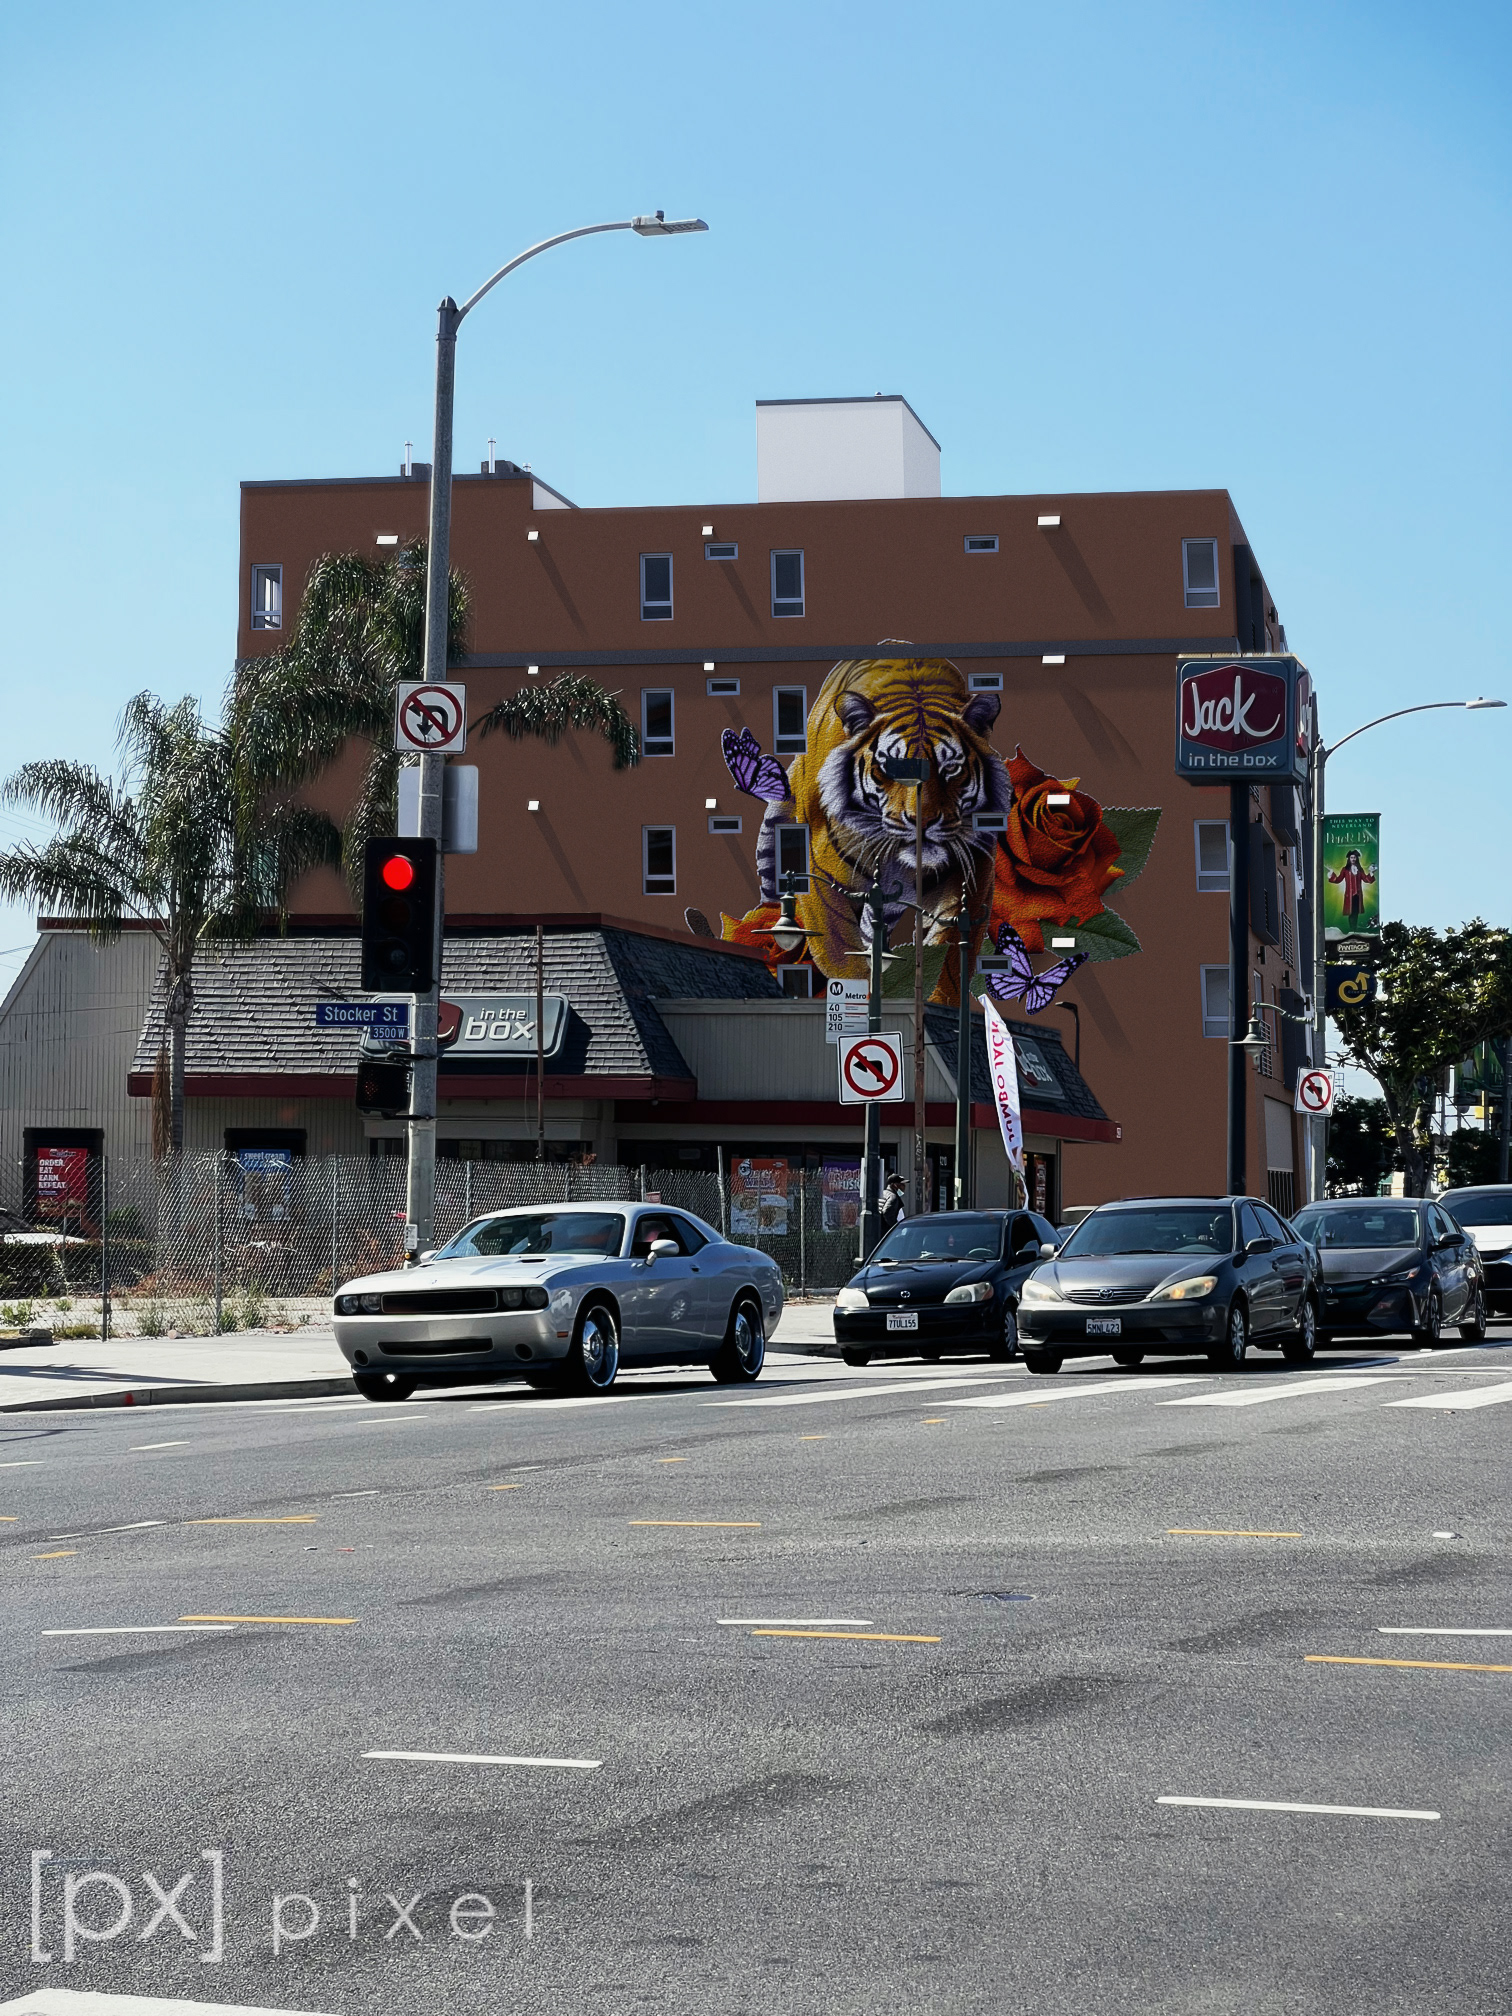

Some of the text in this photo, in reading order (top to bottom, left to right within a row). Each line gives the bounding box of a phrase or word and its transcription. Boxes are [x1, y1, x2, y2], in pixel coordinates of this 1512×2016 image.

[1185, 675, 1281, 737] Jack
[1189, 753, 1277, 767] in the box
[829, 1004, 840, 1012] 40
[324, 1006, 398, 1022] Stocker St
[480, 1008, 526, 1020] in the
[829, 1013, 843, 1022] 105
[464, 1016, 536, 1041] box
[828, 1023, 843, 1031] 210
[373, 1028, 405, 1038] 3500 W
[39, 1158, 66, 1167] ORDER.
[889, 1319, 917, 1329] 7TUL155
